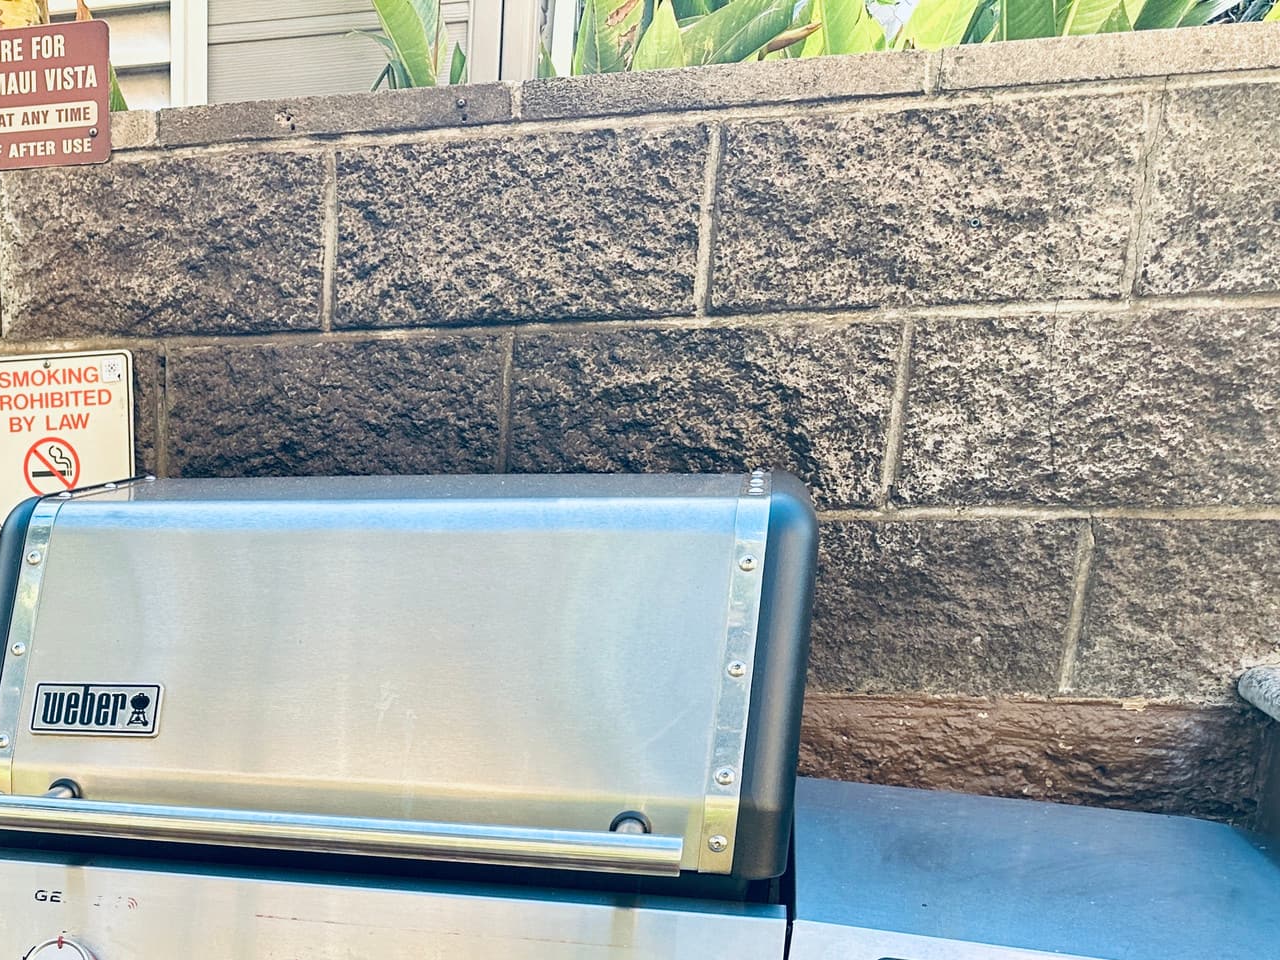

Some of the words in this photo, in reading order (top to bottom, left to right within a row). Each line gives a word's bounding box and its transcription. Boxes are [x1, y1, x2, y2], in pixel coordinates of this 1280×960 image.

[31, 34, 65, 60] FOR
[44, 65, 98, 92] VISTA
[21, 110, 49, 126] ANY
[55, 106, 91, 123] TIME
[8, 140, 56, 159] AFTER
[62, 138, 92, 154] USE
[9, 416, 35, 433] BY
[46, 412, 90, 431] LAW
[42, 685, 127, 726] weber
